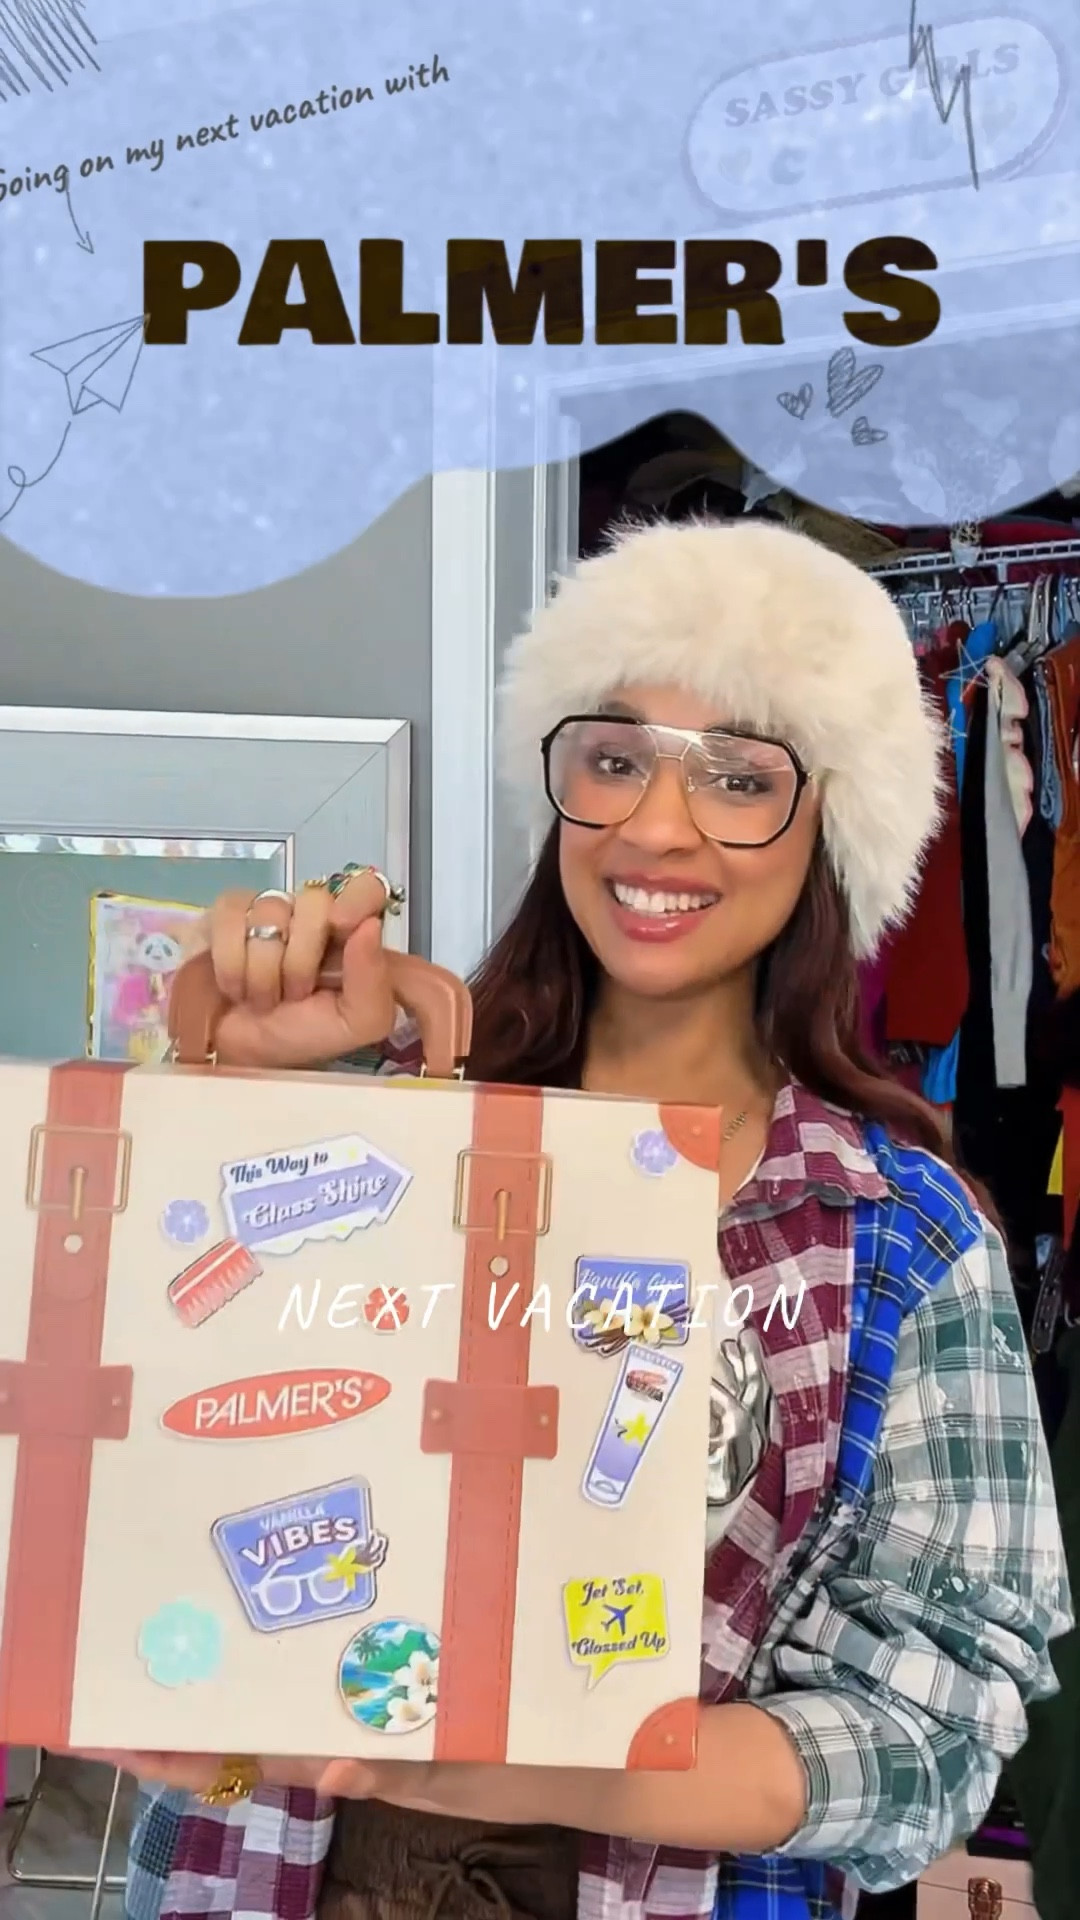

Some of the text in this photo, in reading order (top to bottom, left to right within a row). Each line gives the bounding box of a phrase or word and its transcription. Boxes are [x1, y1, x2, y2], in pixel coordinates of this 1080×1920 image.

[724, 42, 1021, 128] SASSY GIRLS
[229, 1151, 329, 1184] This Way to
[318, 1174, 390, 1208] Shine
[194, 1375, 366, 1430] PALMER'S
[240, 1516, 359, 1568] VIBES
[580, 1581, 608, 1607] Jet
[571, 1631, 666, 1657] Glossed Up
